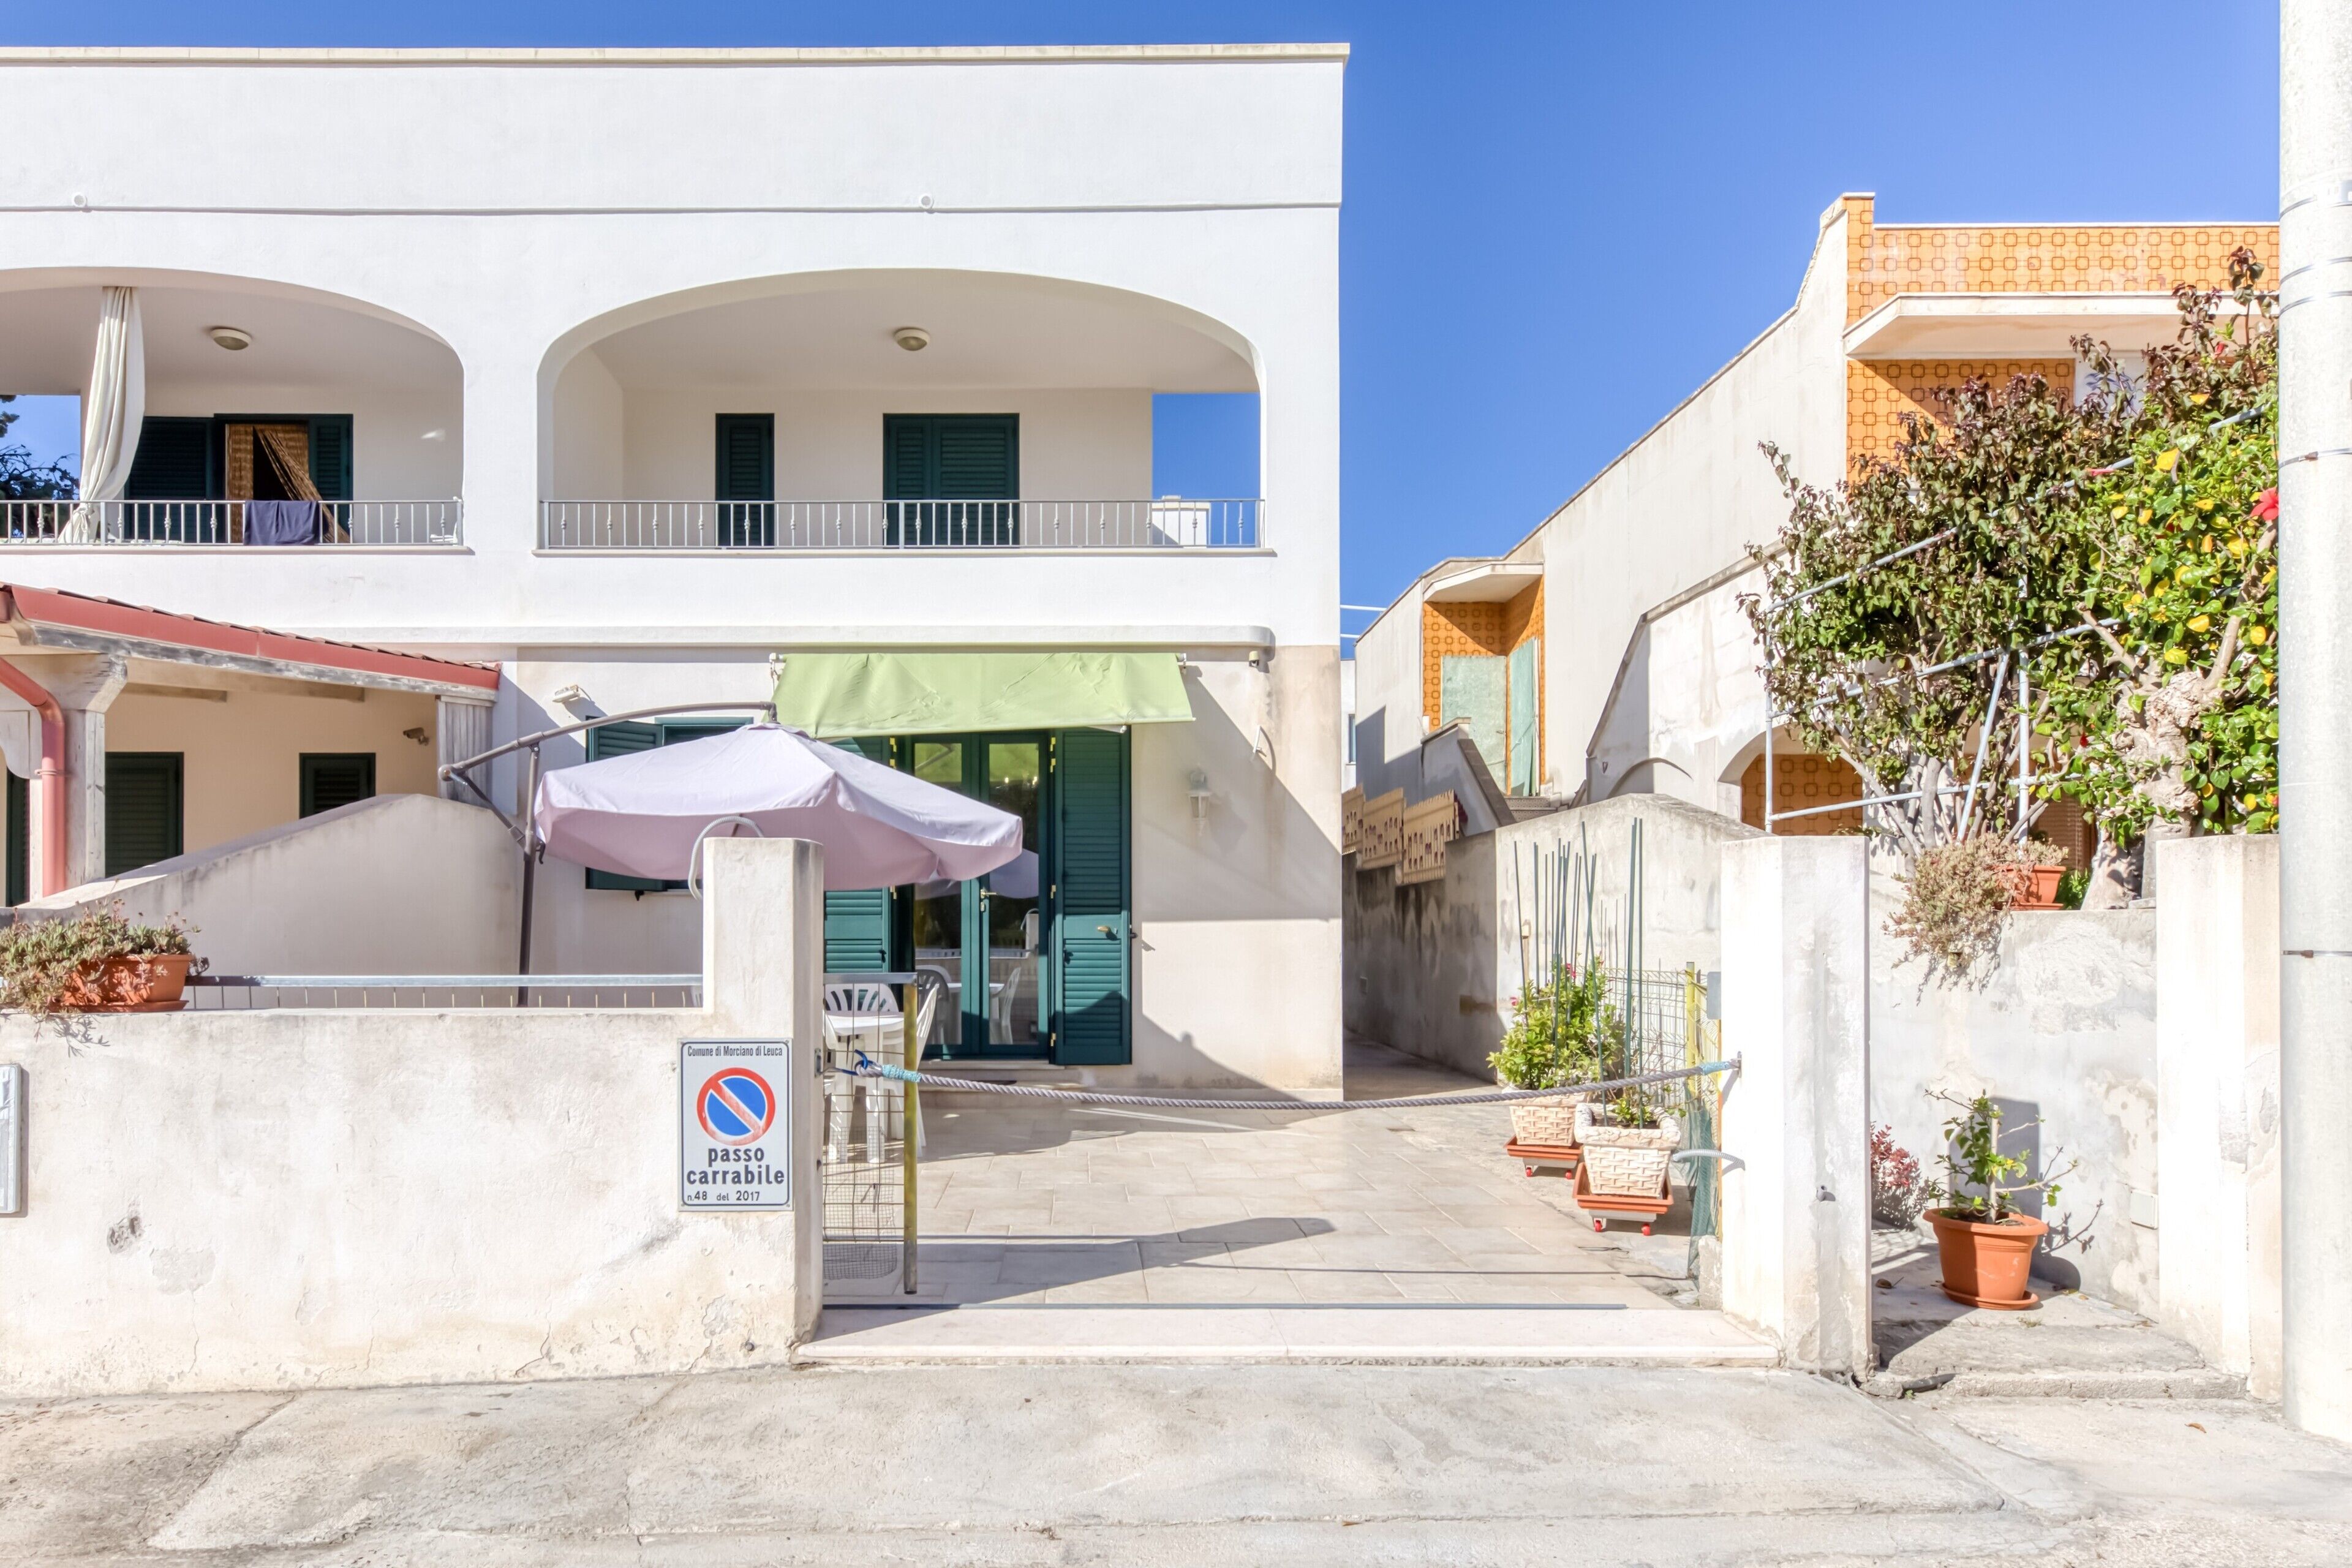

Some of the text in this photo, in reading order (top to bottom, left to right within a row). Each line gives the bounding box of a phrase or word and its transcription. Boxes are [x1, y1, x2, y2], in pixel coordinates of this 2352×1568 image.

[687, 1046, 783, 1057] Comune di Morciano di Leuca
[708, 1147, 764, 1167] passo
[686, 1164, 785, 1185] carrabile
[716, 1193, 729, 1201] del
[736, 1190, 760, 1201] 2017
